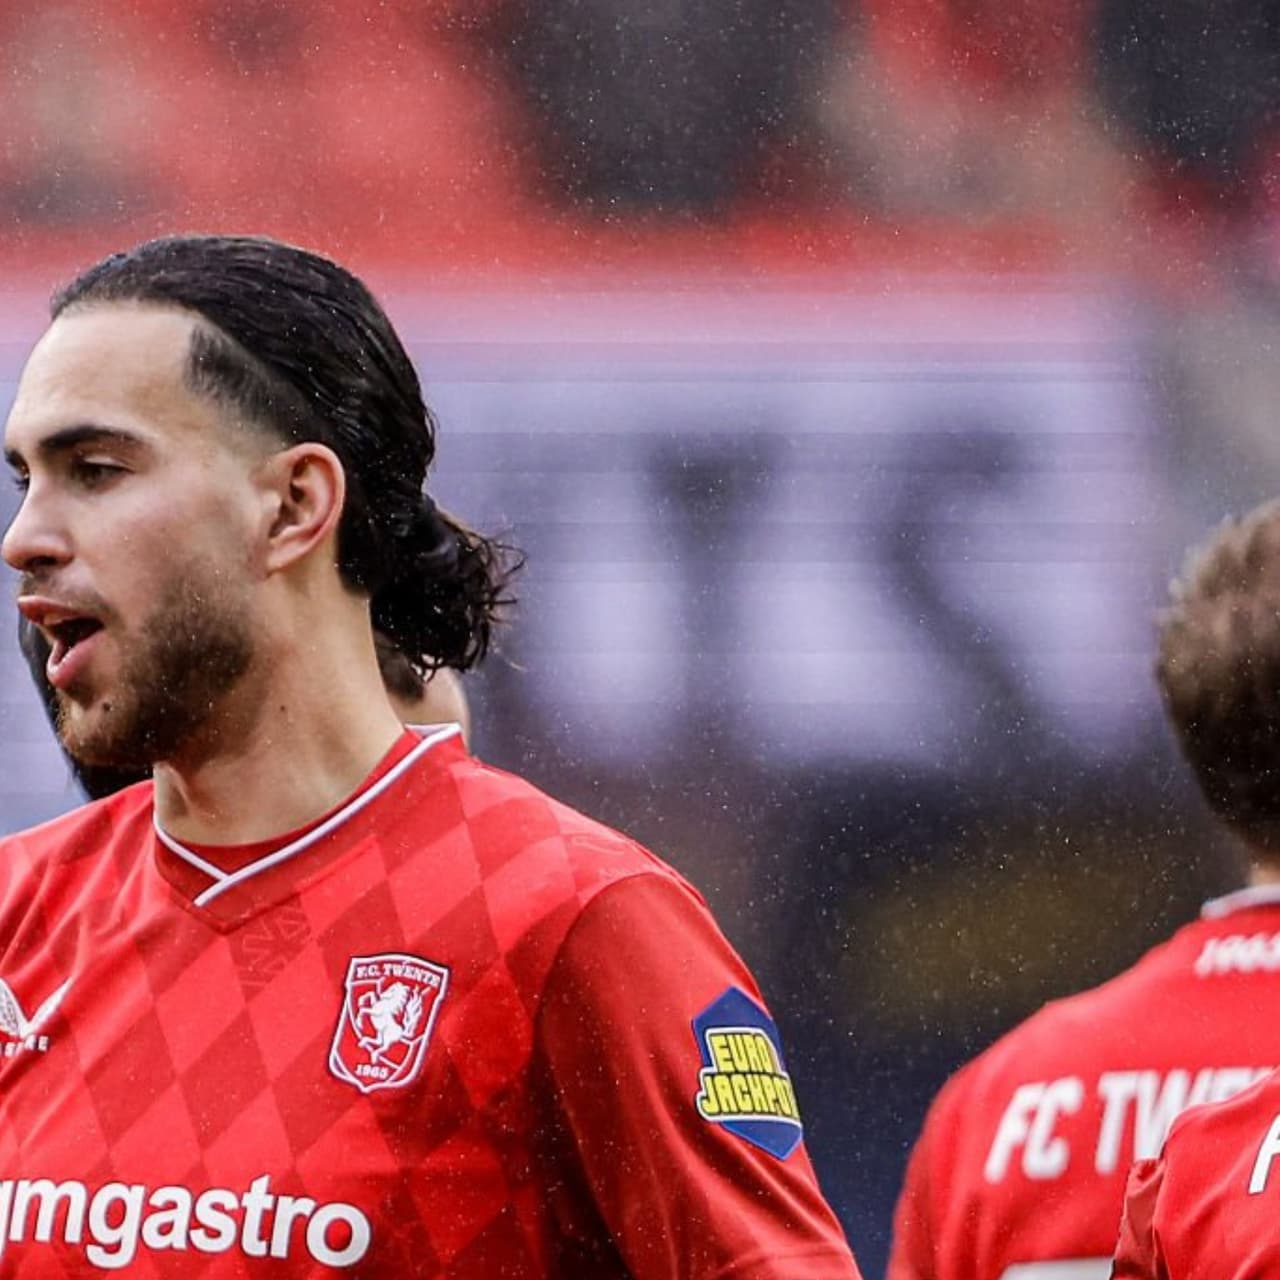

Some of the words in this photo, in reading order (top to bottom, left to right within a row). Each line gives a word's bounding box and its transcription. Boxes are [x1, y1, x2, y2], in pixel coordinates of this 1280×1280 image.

[383, 962, 441, 988] TWENTE
[709, 1033, 775, 1073] EURO
[985, 1076, 1084, 1183] FC
